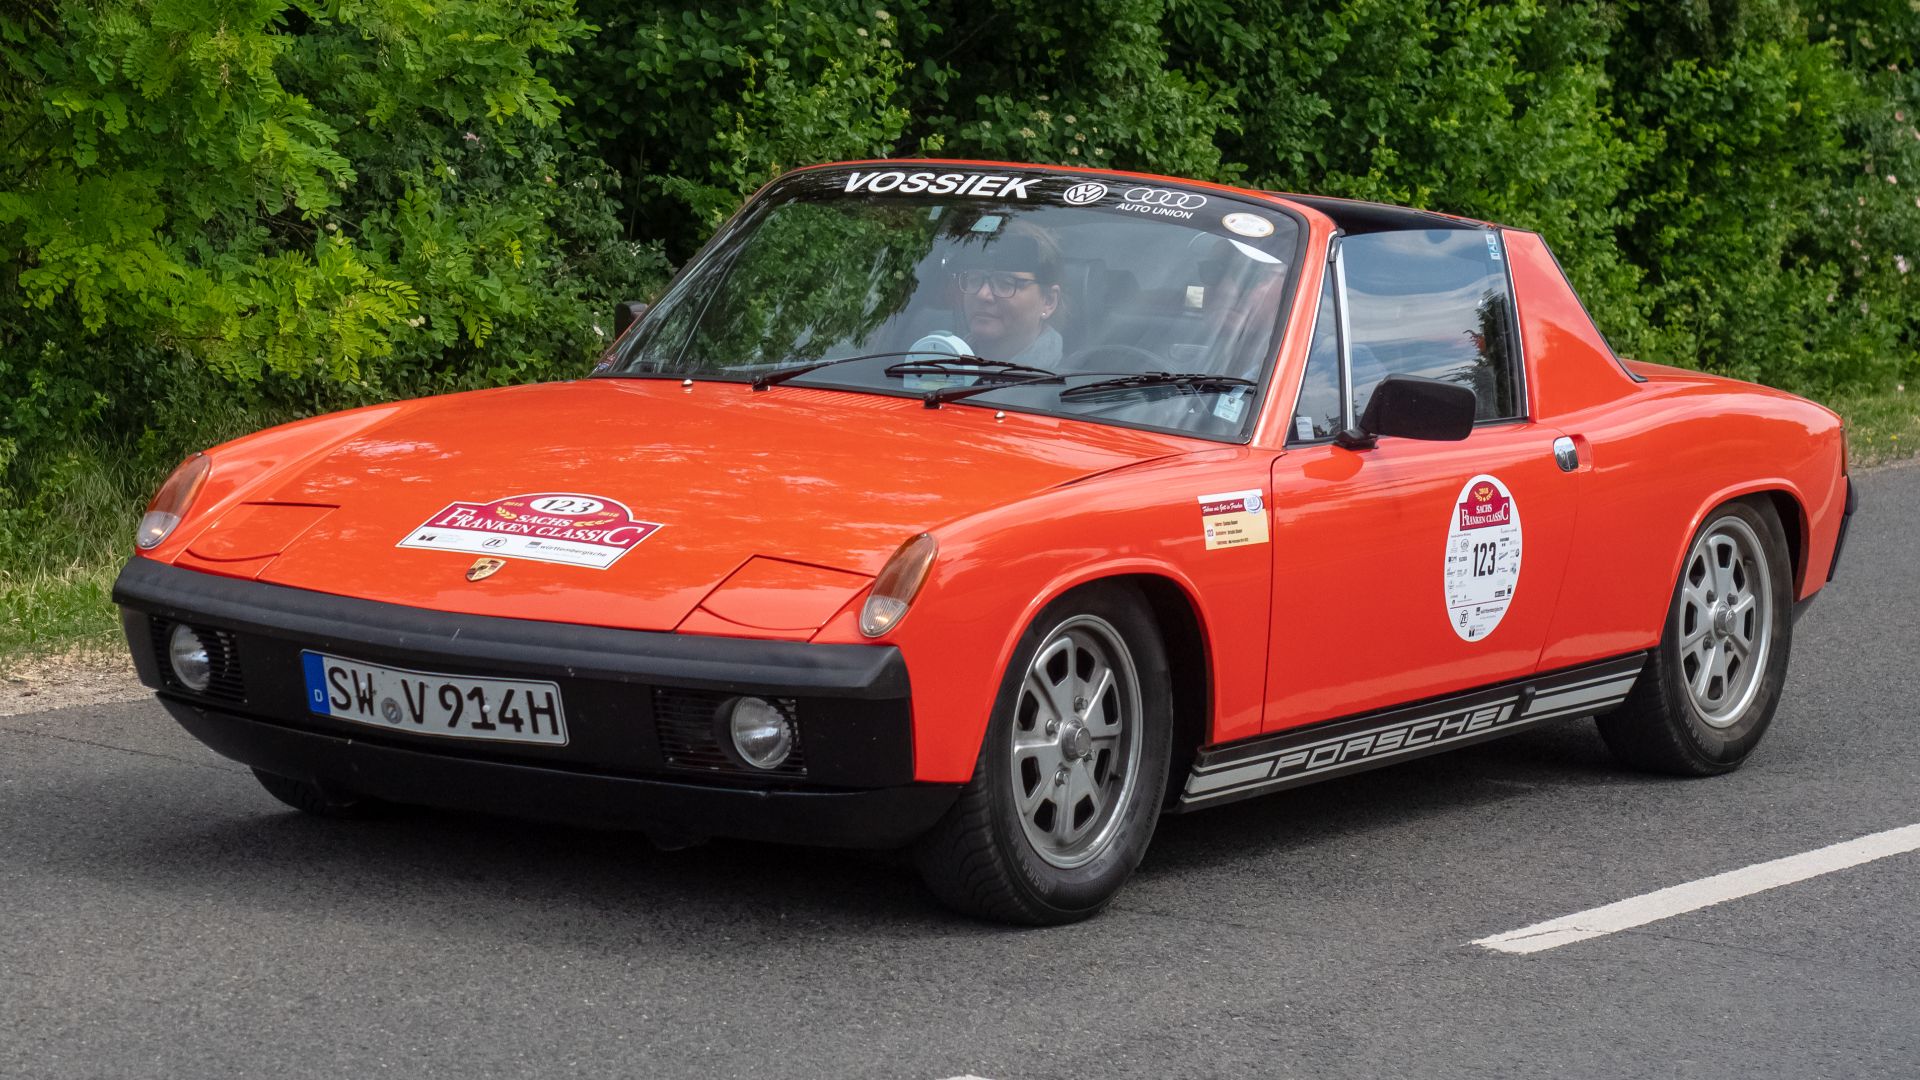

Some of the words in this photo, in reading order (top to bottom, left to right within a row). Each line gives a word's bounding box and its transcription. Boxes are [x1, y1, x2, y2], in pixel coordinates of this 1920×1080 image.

[843, 172, 1043, 200] VOSSIEK
[1116, 202, 1152, 214] AUTO
[1152, 206, 1194, 220] UNION
[538, 497, 596, 514] 123
[1476, 503, 1493, 514] SACHS
[435, 507, 534, 536] FRANKEN
[535, 525, 641, 546] CLASSIC
[515, 514, 574, 528] SACHS
[1473, 541, 1497, 577] 123
[313, 688, 324, 703] D
[327, 666, 375, 717] SW
[400, 678, 427, 725] V
[438, 682, 560, 736] 914H
[1271, 706, 1500, 777] PORSCHE
